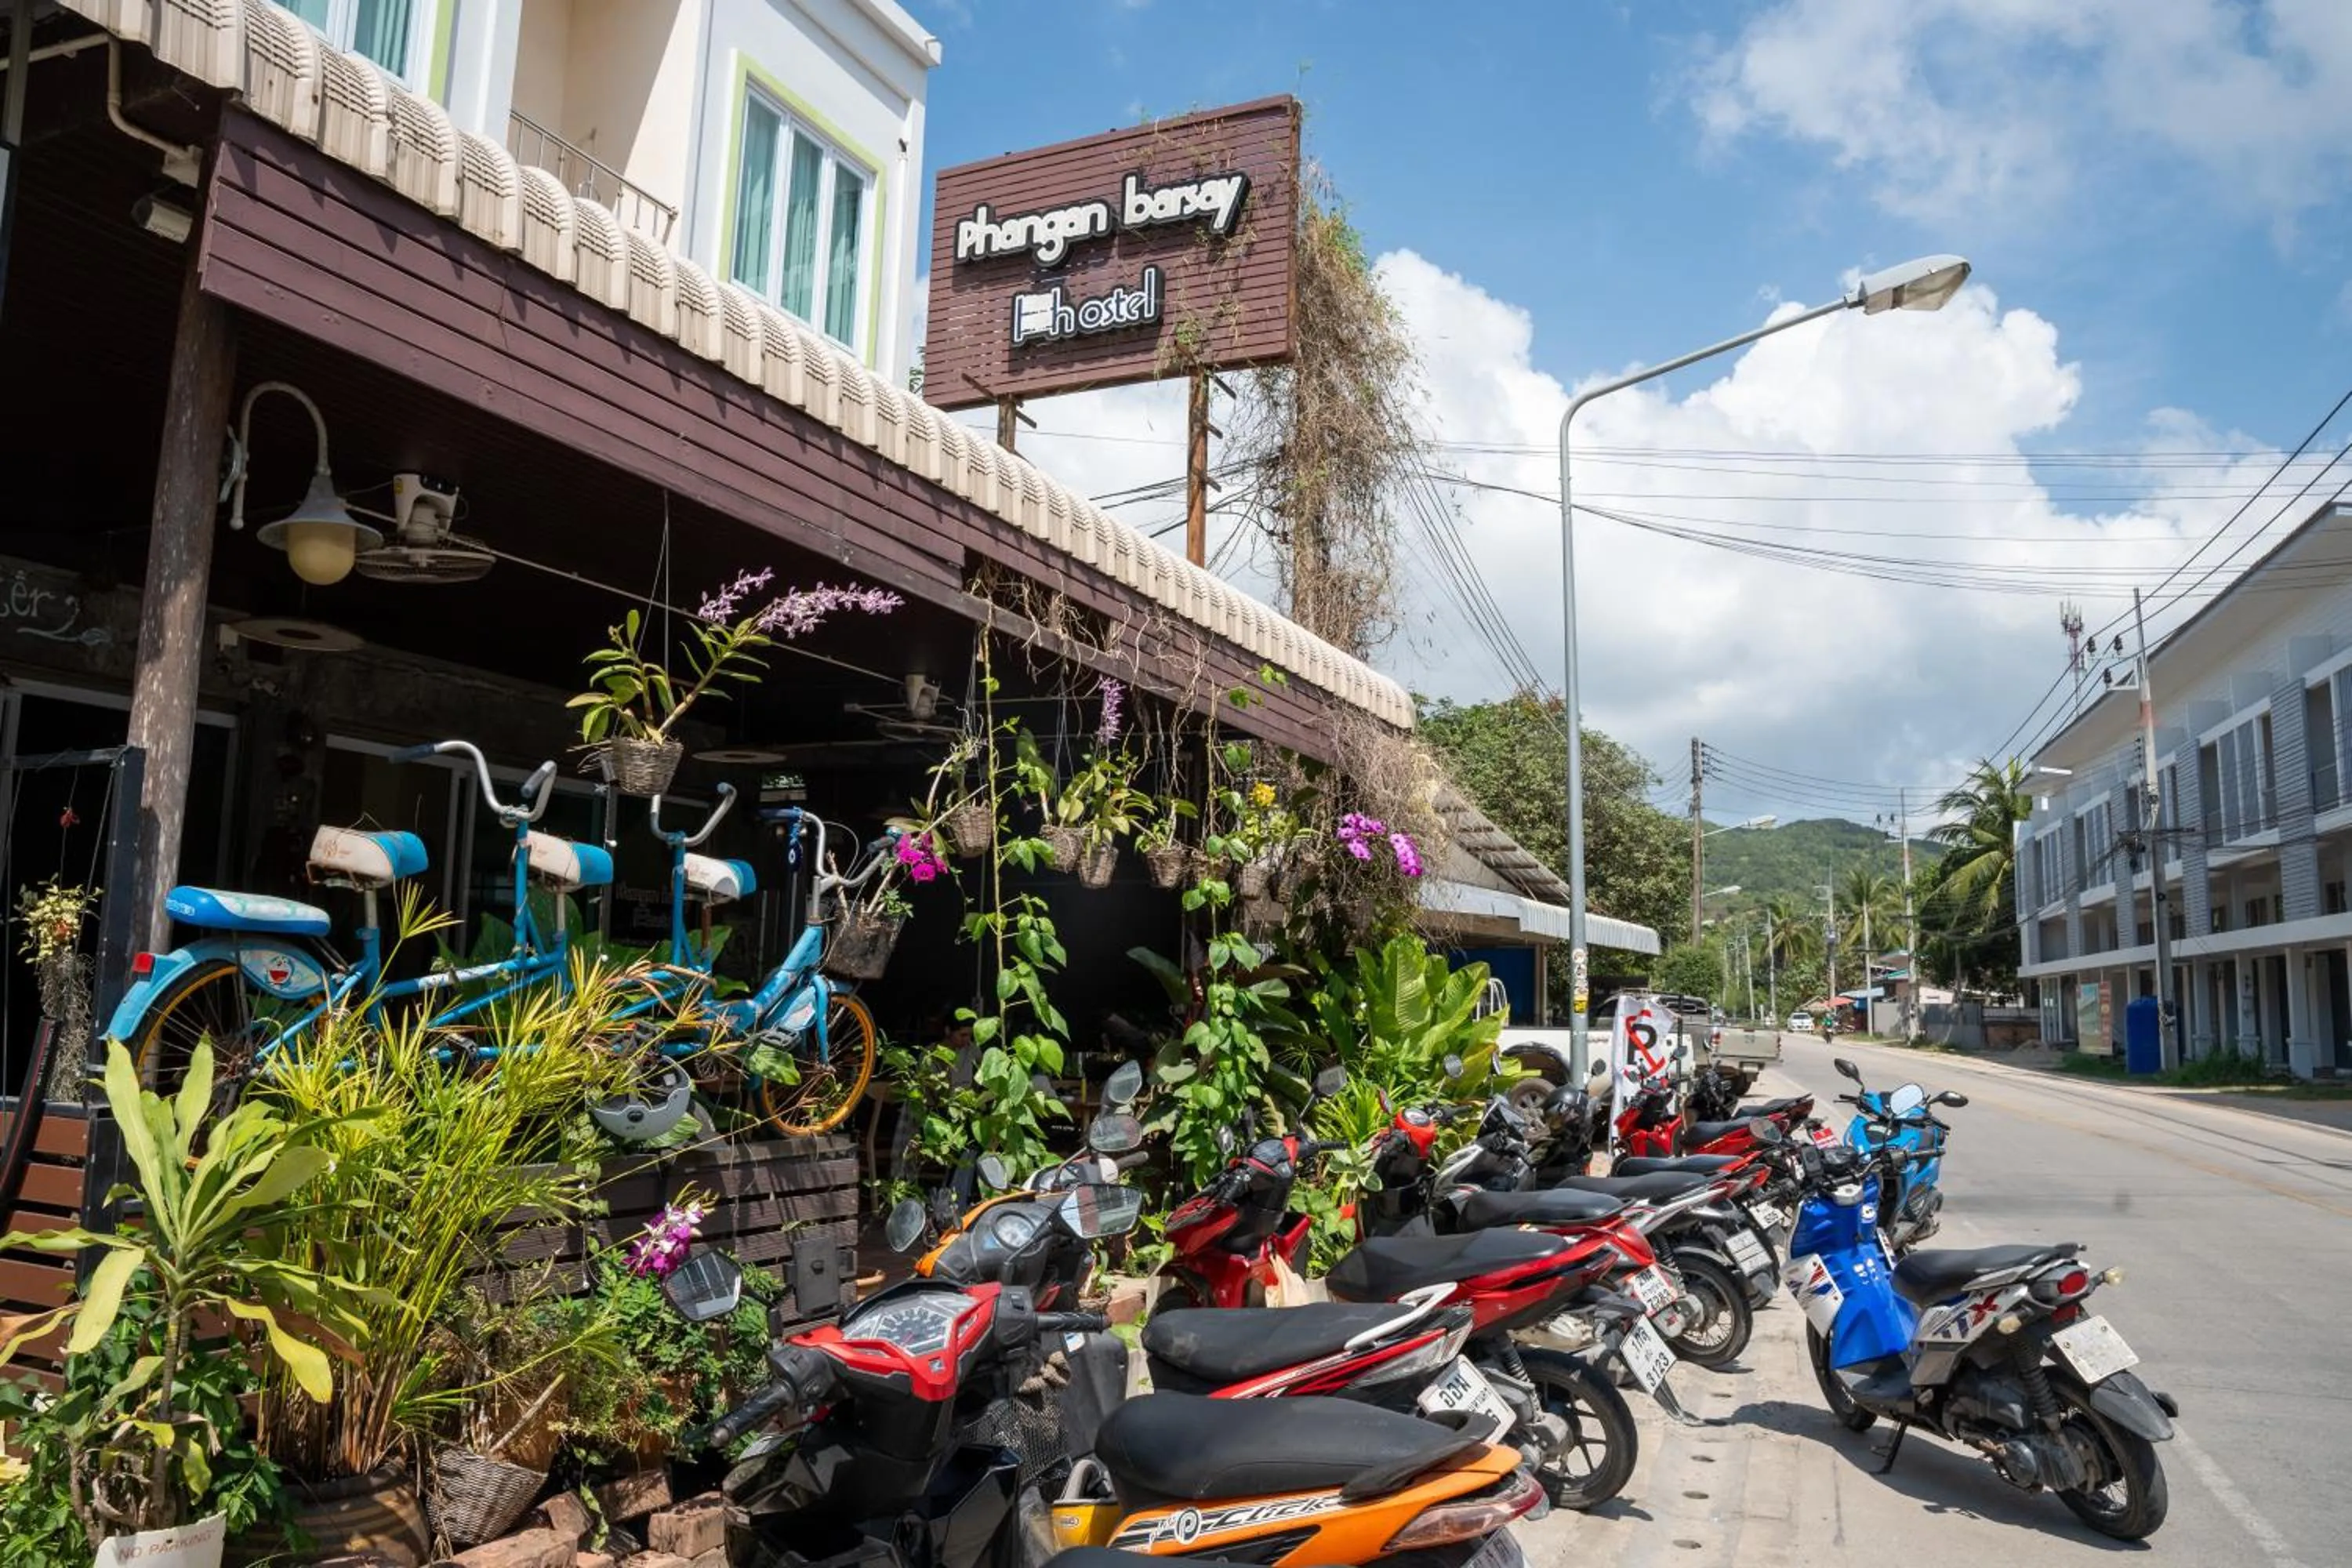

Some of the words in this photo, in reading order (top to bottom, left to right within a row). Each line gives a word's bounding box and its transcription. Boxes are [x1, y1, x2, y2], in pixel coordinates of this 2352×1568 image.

[1123, 175, 1243, 230] barsay
[1049, 267, 1155, 336] hostel
[118, 1547, 142, 1560] NO
